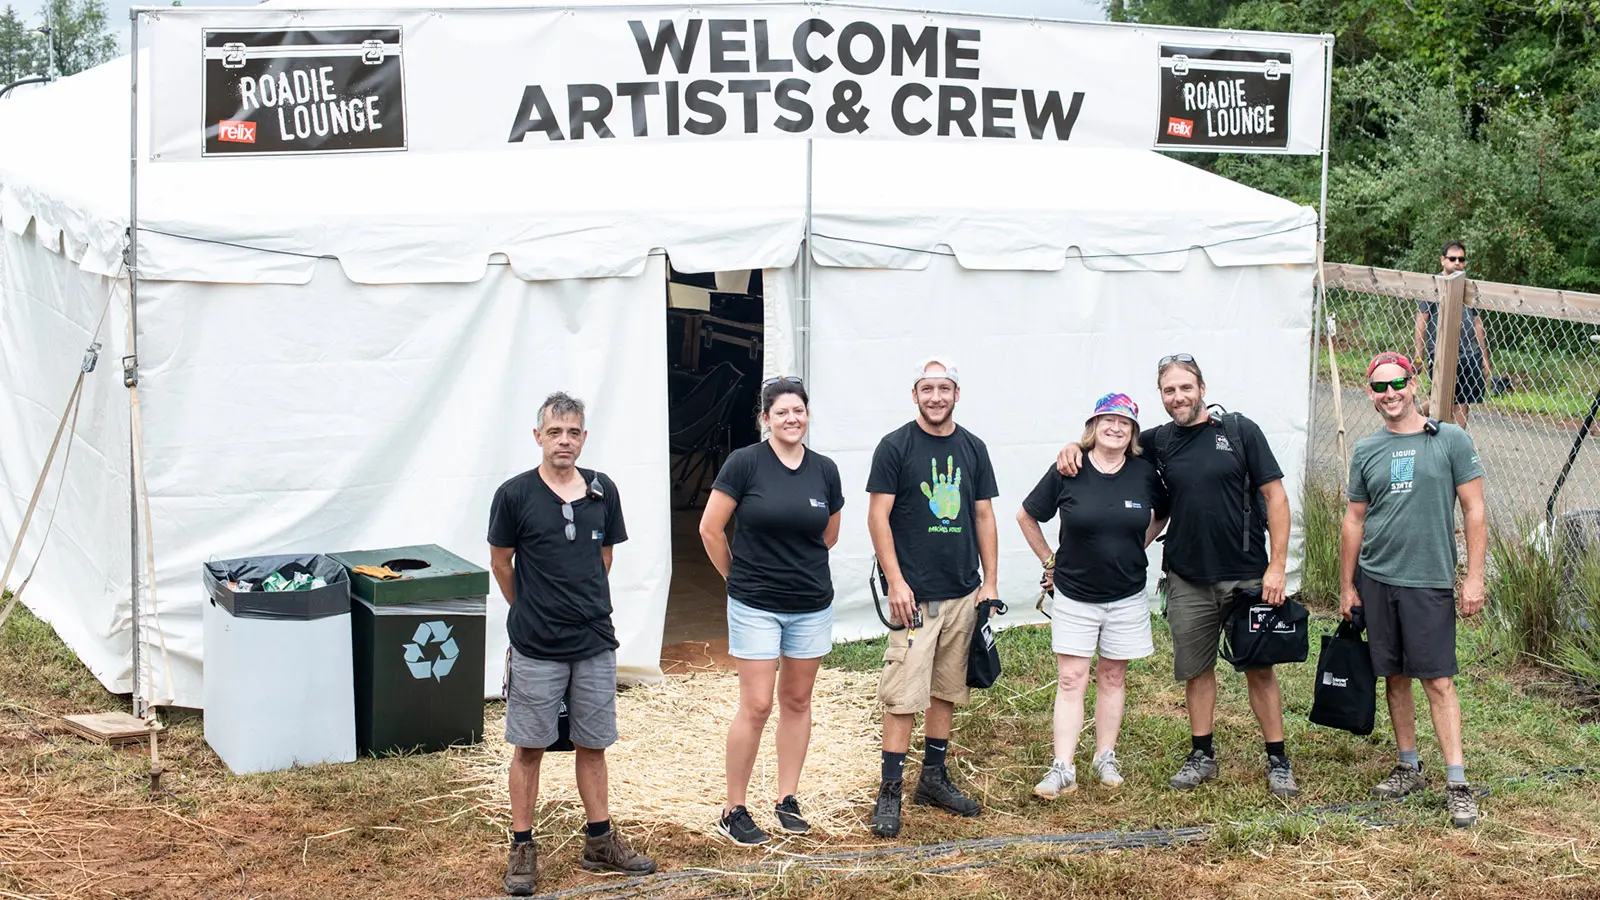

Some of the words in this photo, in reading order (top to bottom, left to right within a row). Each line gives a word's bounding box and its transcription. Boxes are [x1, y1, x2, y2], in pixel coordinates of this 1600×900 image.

[627, 19, 981, 80] WELCOME
[240, 66, 337, 111] ROADIE
[1184, 79, 1247, 111] ROADIE
[278, 96, 383, 141] LOUNGE
[507, 78, 814, 143] ARTISTS
[825, 79, 870, 134] &
[891, 83, 1085, 141] CREW
[1206, 105, 1275, 137] LOUNGE
[219, 123, 255, 142] relix
[1168, 120, 1192, 136] relix
[1392, 449, 1416, 458] LIQUID
[1391, 481, 1413, 490] STATE
